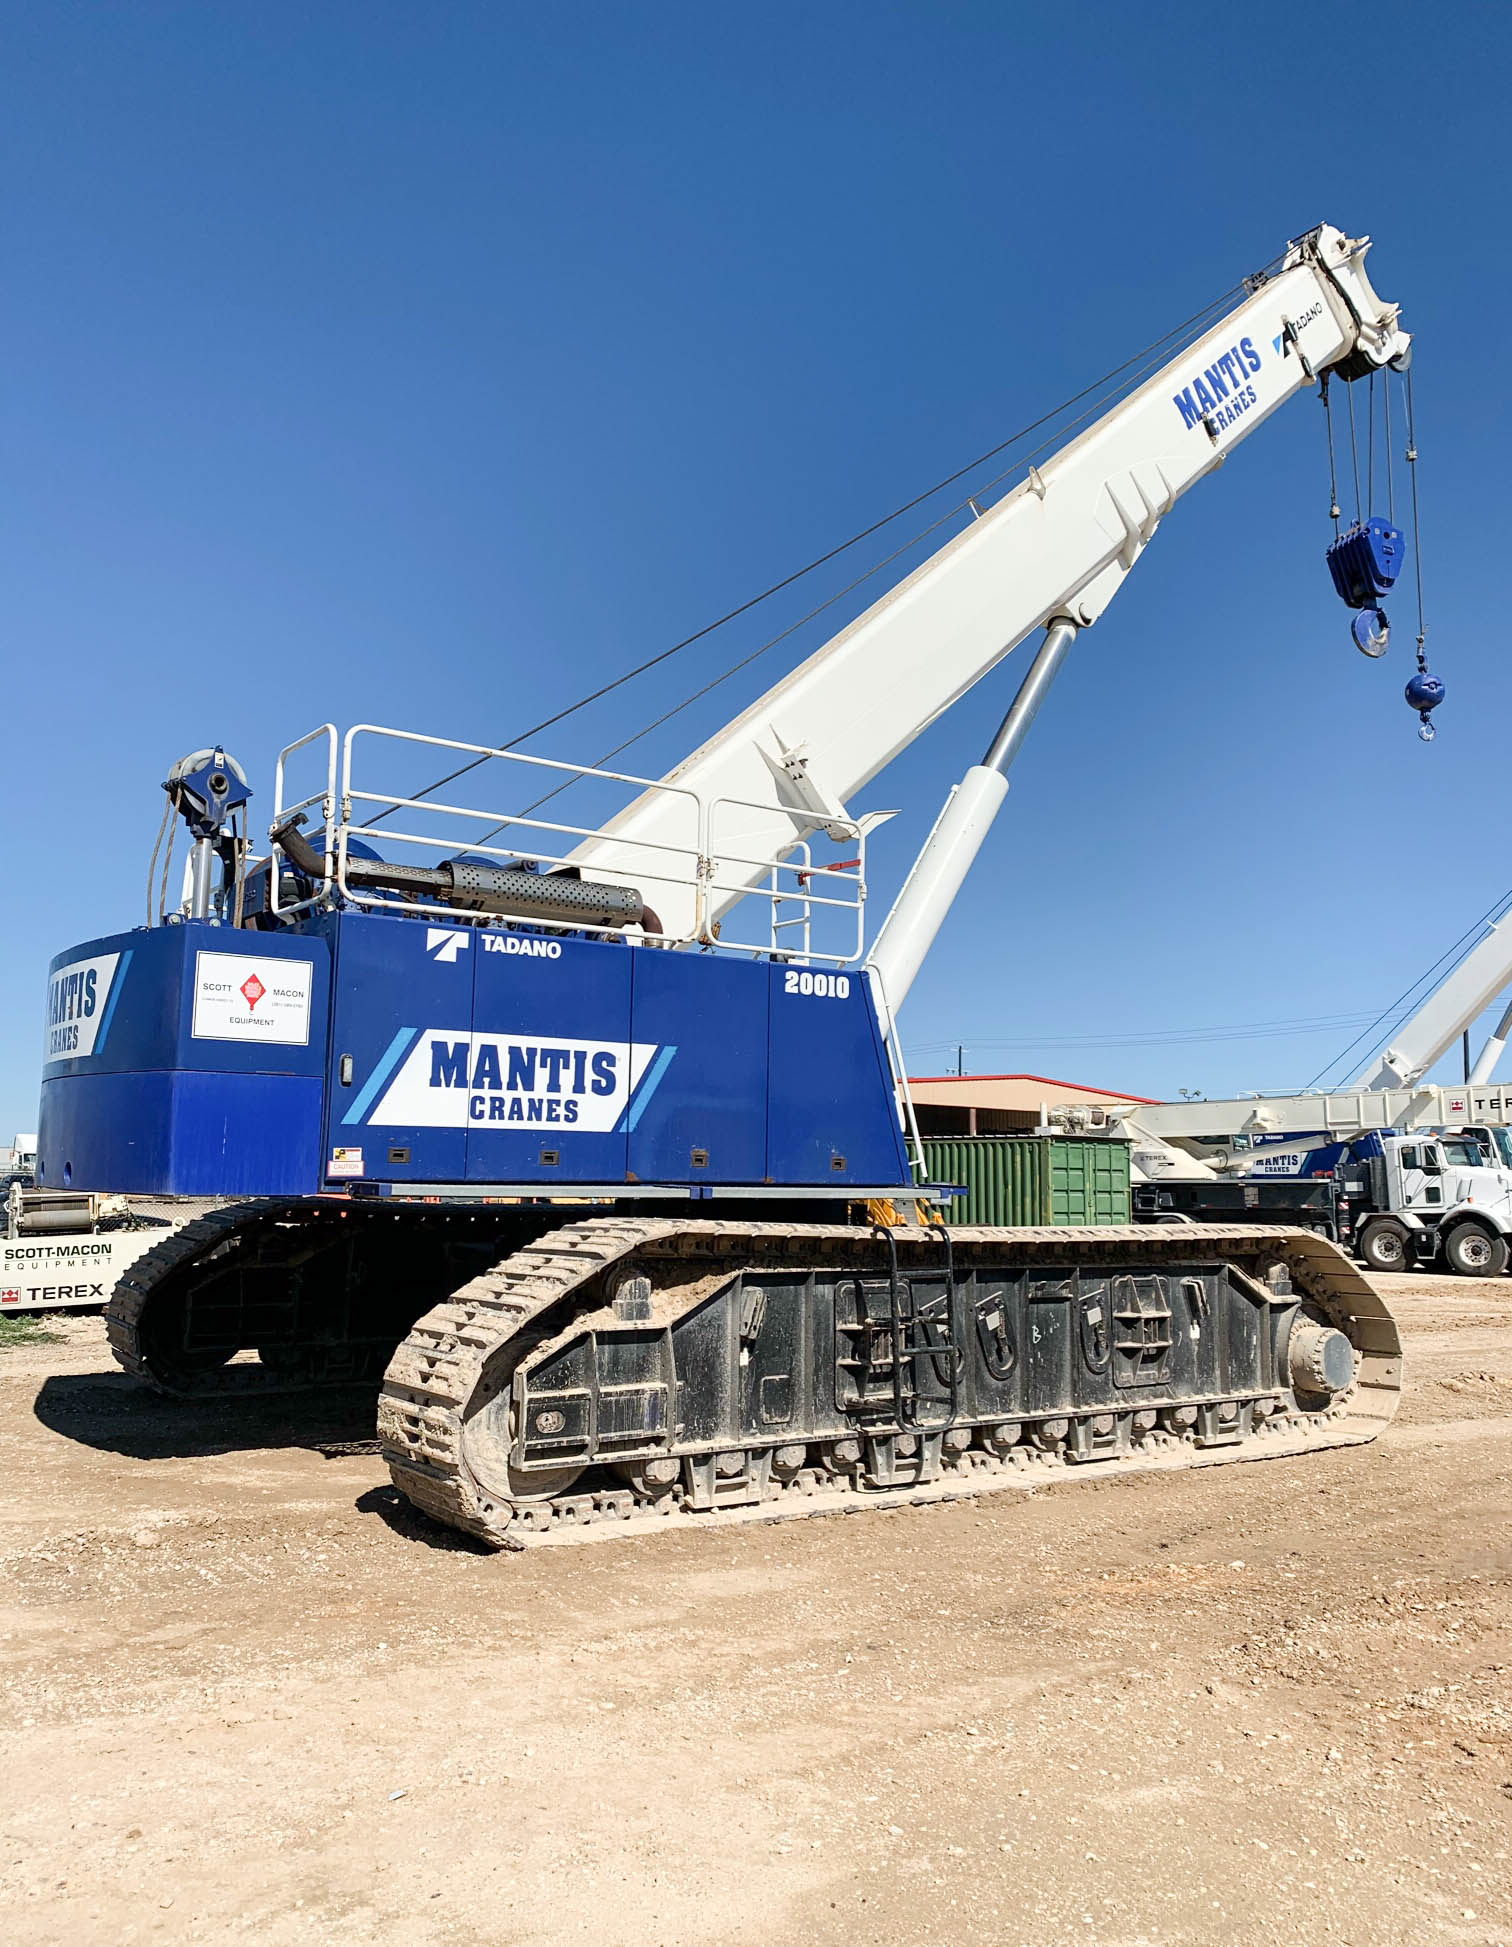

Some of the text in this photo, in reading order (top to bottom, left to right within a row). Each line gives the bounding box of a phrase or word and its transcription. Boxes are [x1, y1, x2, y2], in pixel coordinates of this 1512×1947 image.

[1291, 302, 1322, 332] ADANO
[1172, 337, 1261, 431] MANTIS
[481, 933, 562, 959] TADANO
[203, 982, 232, 992] SCOTT
[273, 989, 304, 998] MACON
[785, 970, 850, 999] 20010
[229, 1016, 275, 1026] EQUIPMENT
[429, 1041, 617, 1096] MANTIS
[469, 1096, 579, 1123] CRANES
[1255, 1154, 1298, 1166] MANTIS
[4, 1243, 112, 1260] SCOTT-MACON
[4, 1257, 112, 1271] EQUIPMENT
[26, 1283, 104, 1301] TEREX
